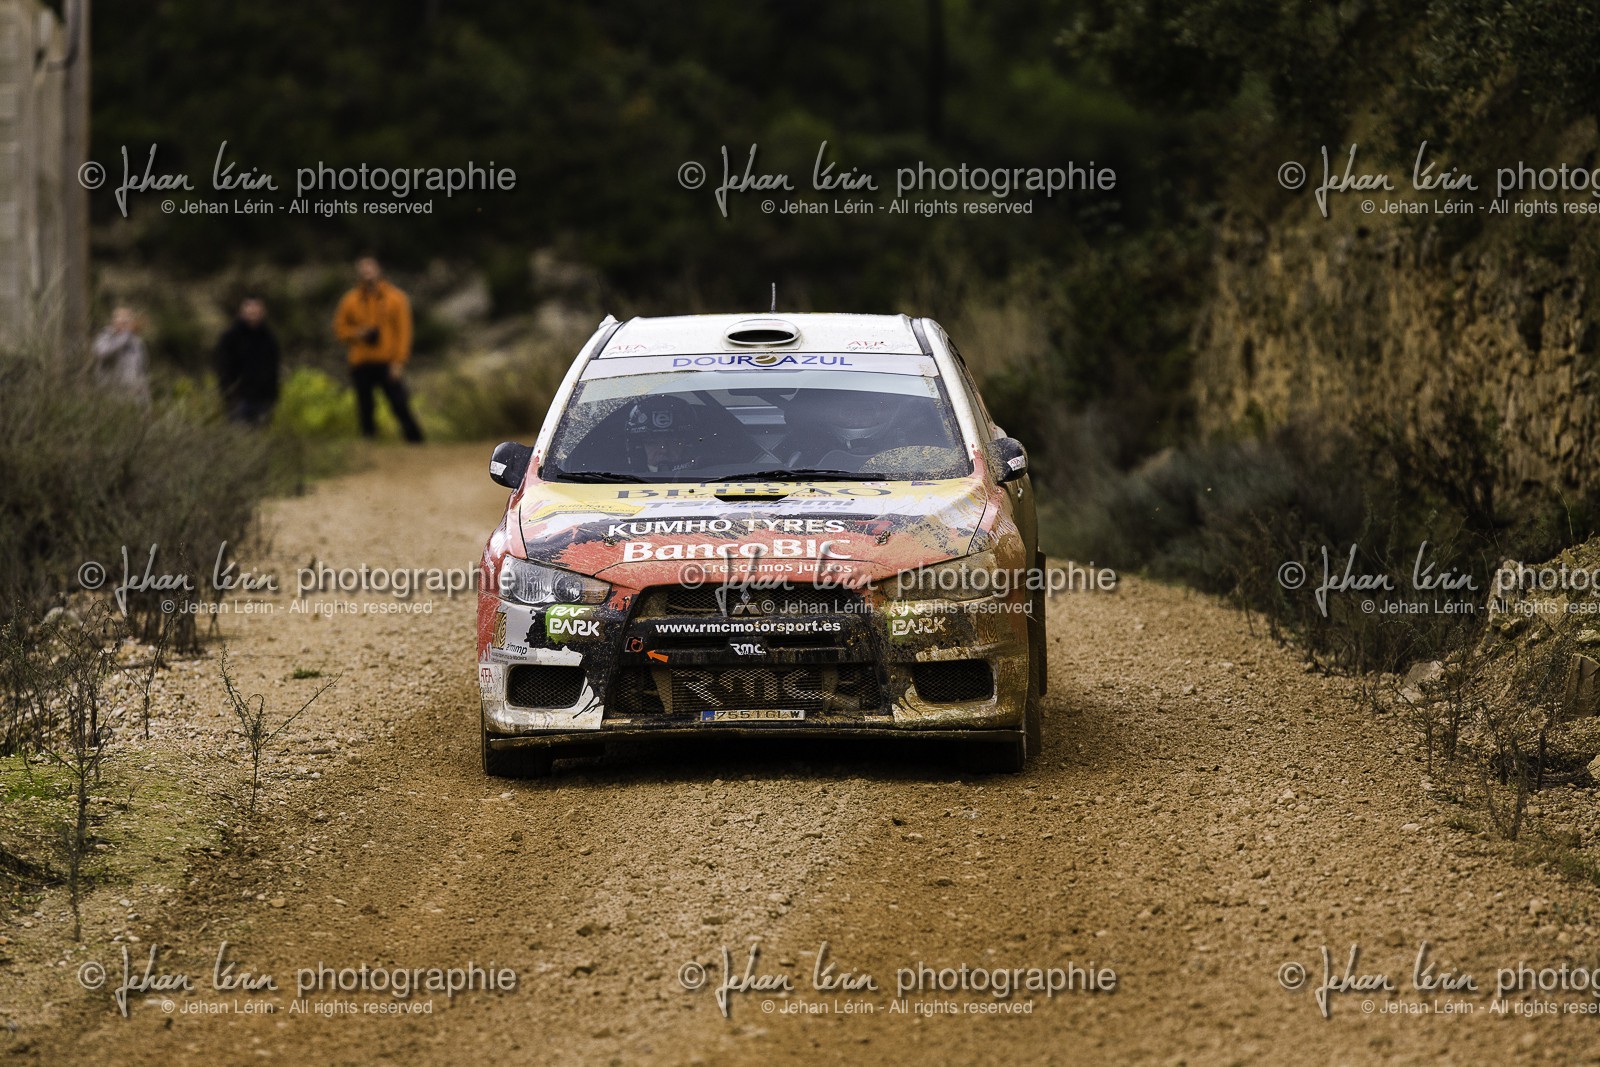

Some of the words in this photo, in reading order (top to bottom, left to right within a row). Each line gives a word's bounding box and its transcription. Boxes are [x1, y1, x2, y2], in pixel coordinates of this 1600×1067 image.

[608, 519, 732, 537] KUMHO
[742, 518, 846, 533] TYRES
[622, 538, 851, 562] BancoBIC
[549, 618, 600, 637] PARK
[655, 620, 842, 635] www.rmcmotorsport.es
